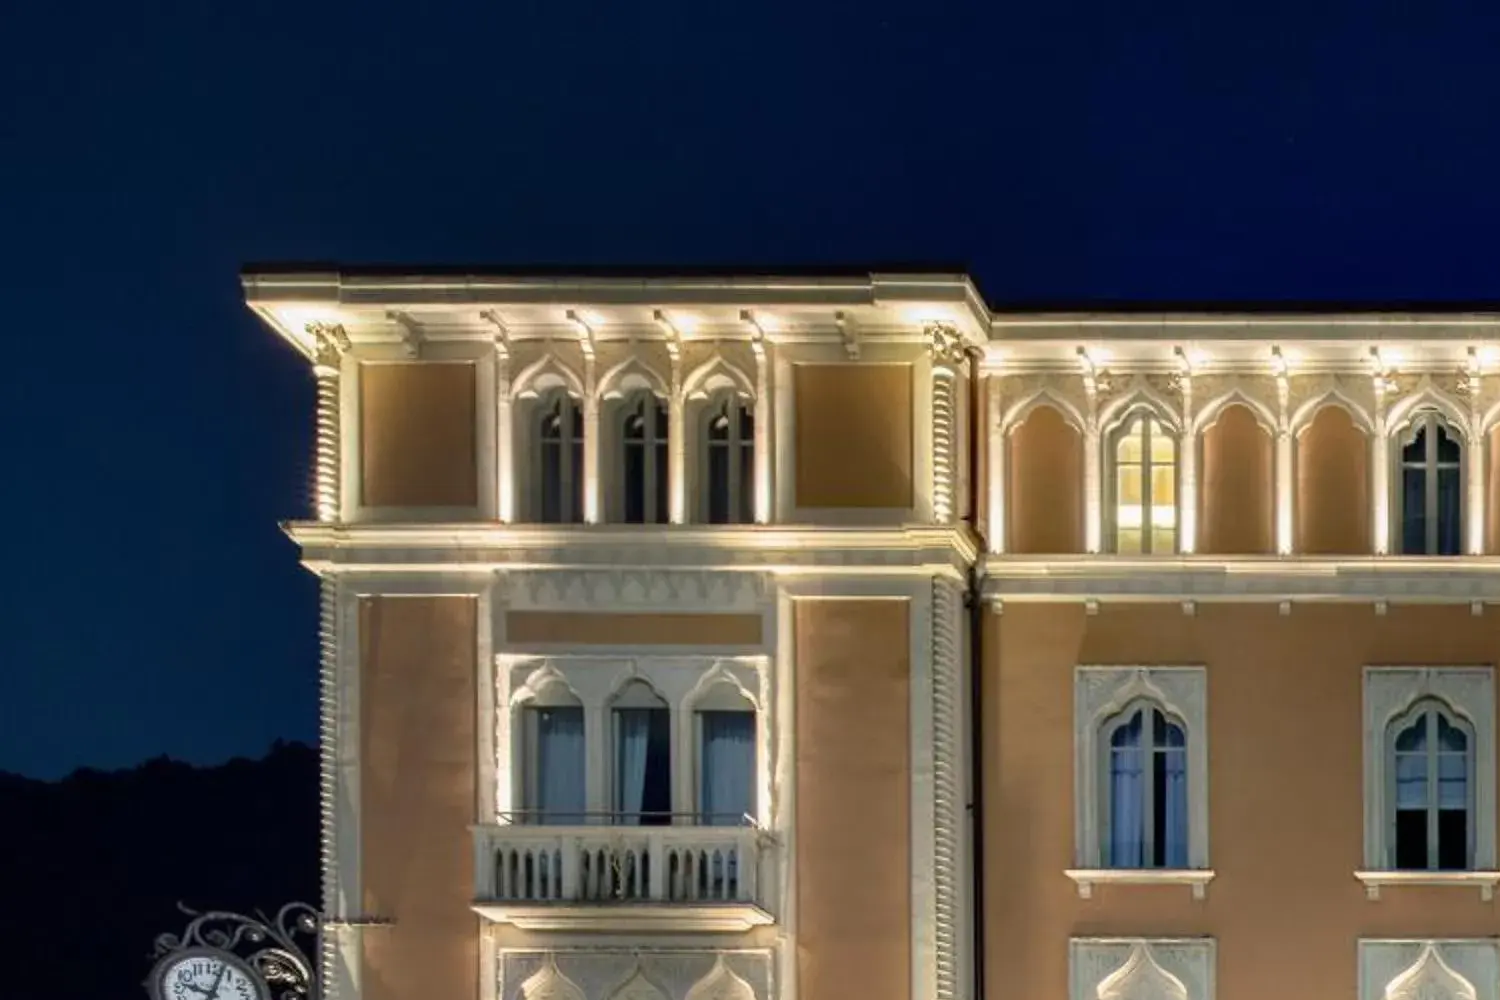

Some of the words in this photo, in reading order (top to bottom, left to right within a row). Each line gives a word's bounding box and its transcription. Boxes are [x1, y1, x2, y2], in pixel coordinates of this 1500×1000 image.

[178, 968, 193, 983] 10
[193, 963, 203, 977] 11
[206, 963, 220, 976] 12
[227, 969, 232, 982] 1
[173, 982, 185, 994] 9
[235, 978, 248, 992] 2
